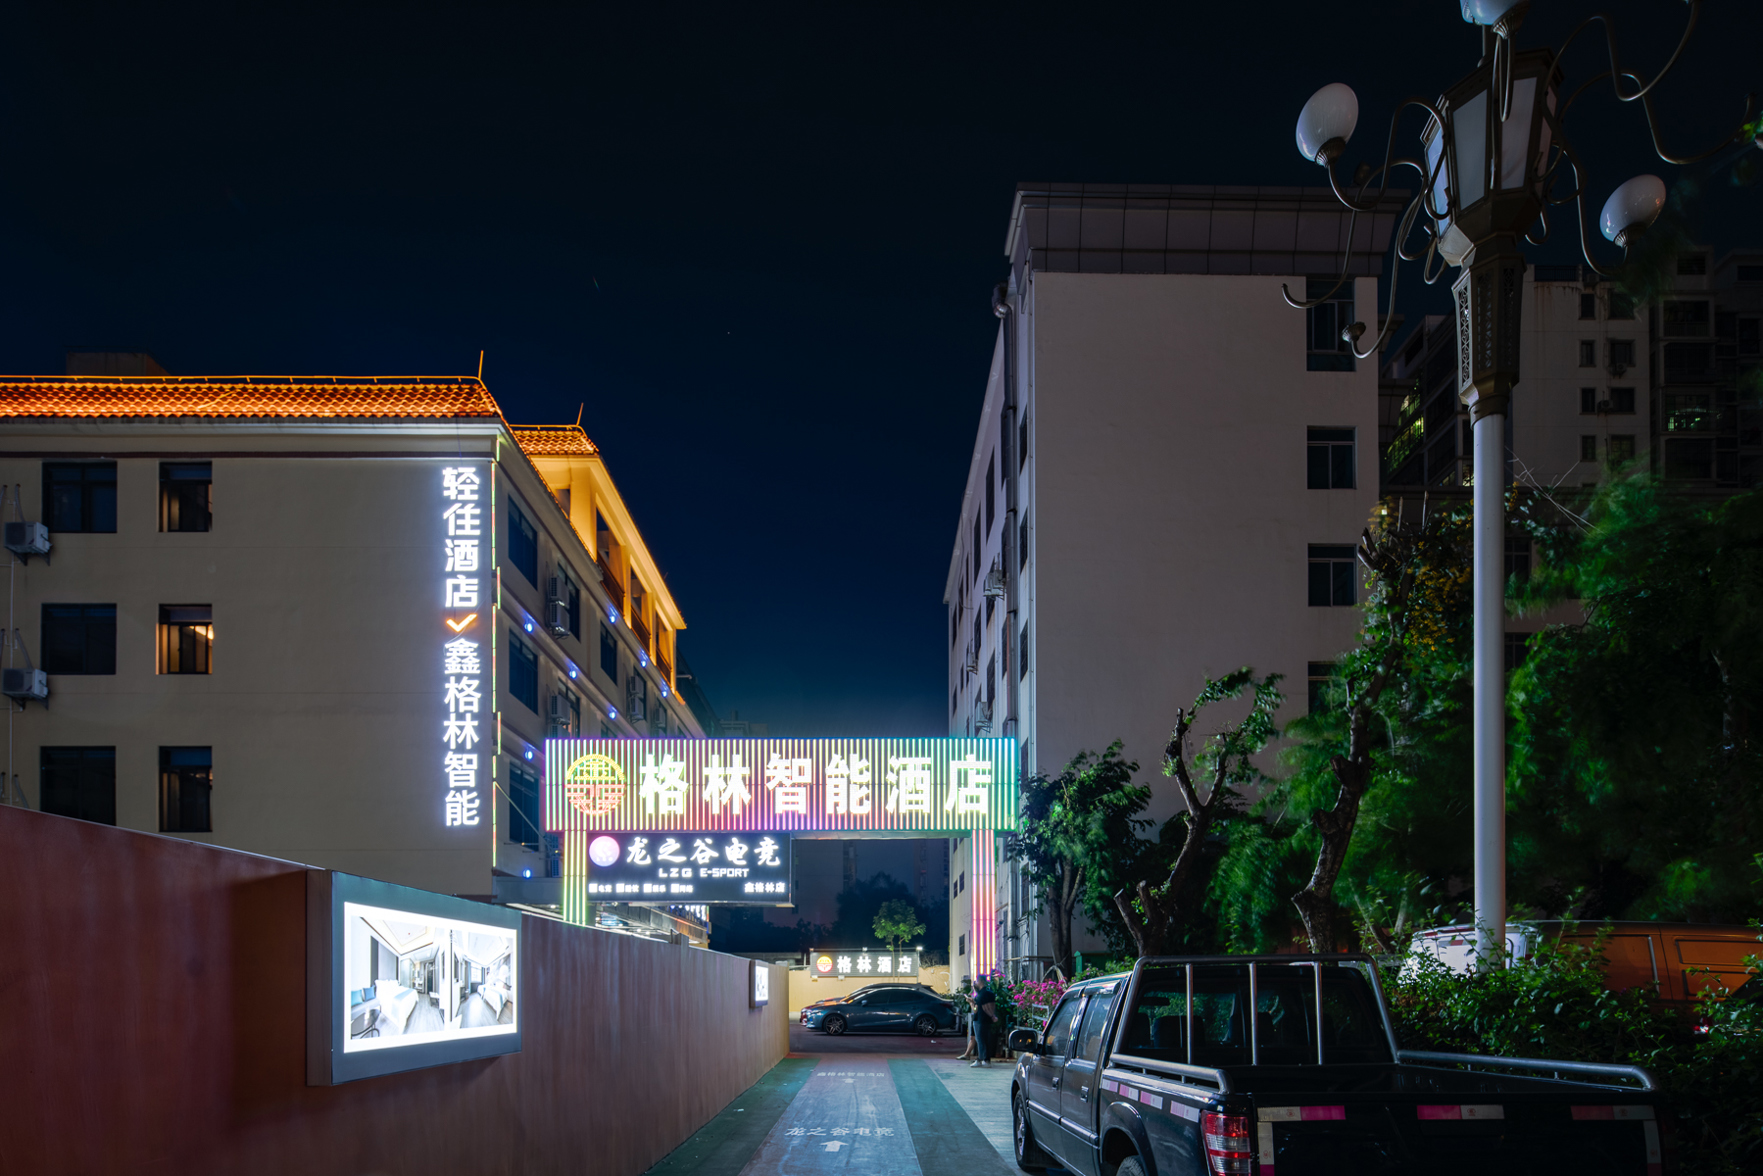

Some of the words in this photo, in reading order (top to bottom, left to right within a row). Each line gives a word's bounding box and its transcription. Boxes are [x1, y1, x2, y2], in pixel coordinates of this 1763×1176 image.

[442, 466, 481, 608] 轻住酒店
[443, 637, 482, 827] 鑫格林智能
[639, 753, 993, 816] 格林智能酒店
[626, 836, 781, 866] 龙之谷电竞
[700, 868, 750, 878] E-SPORT
[837, 955, 912, 973] 格林酒店
[785, 1127, 895, 1136] 龙之谷电竞
